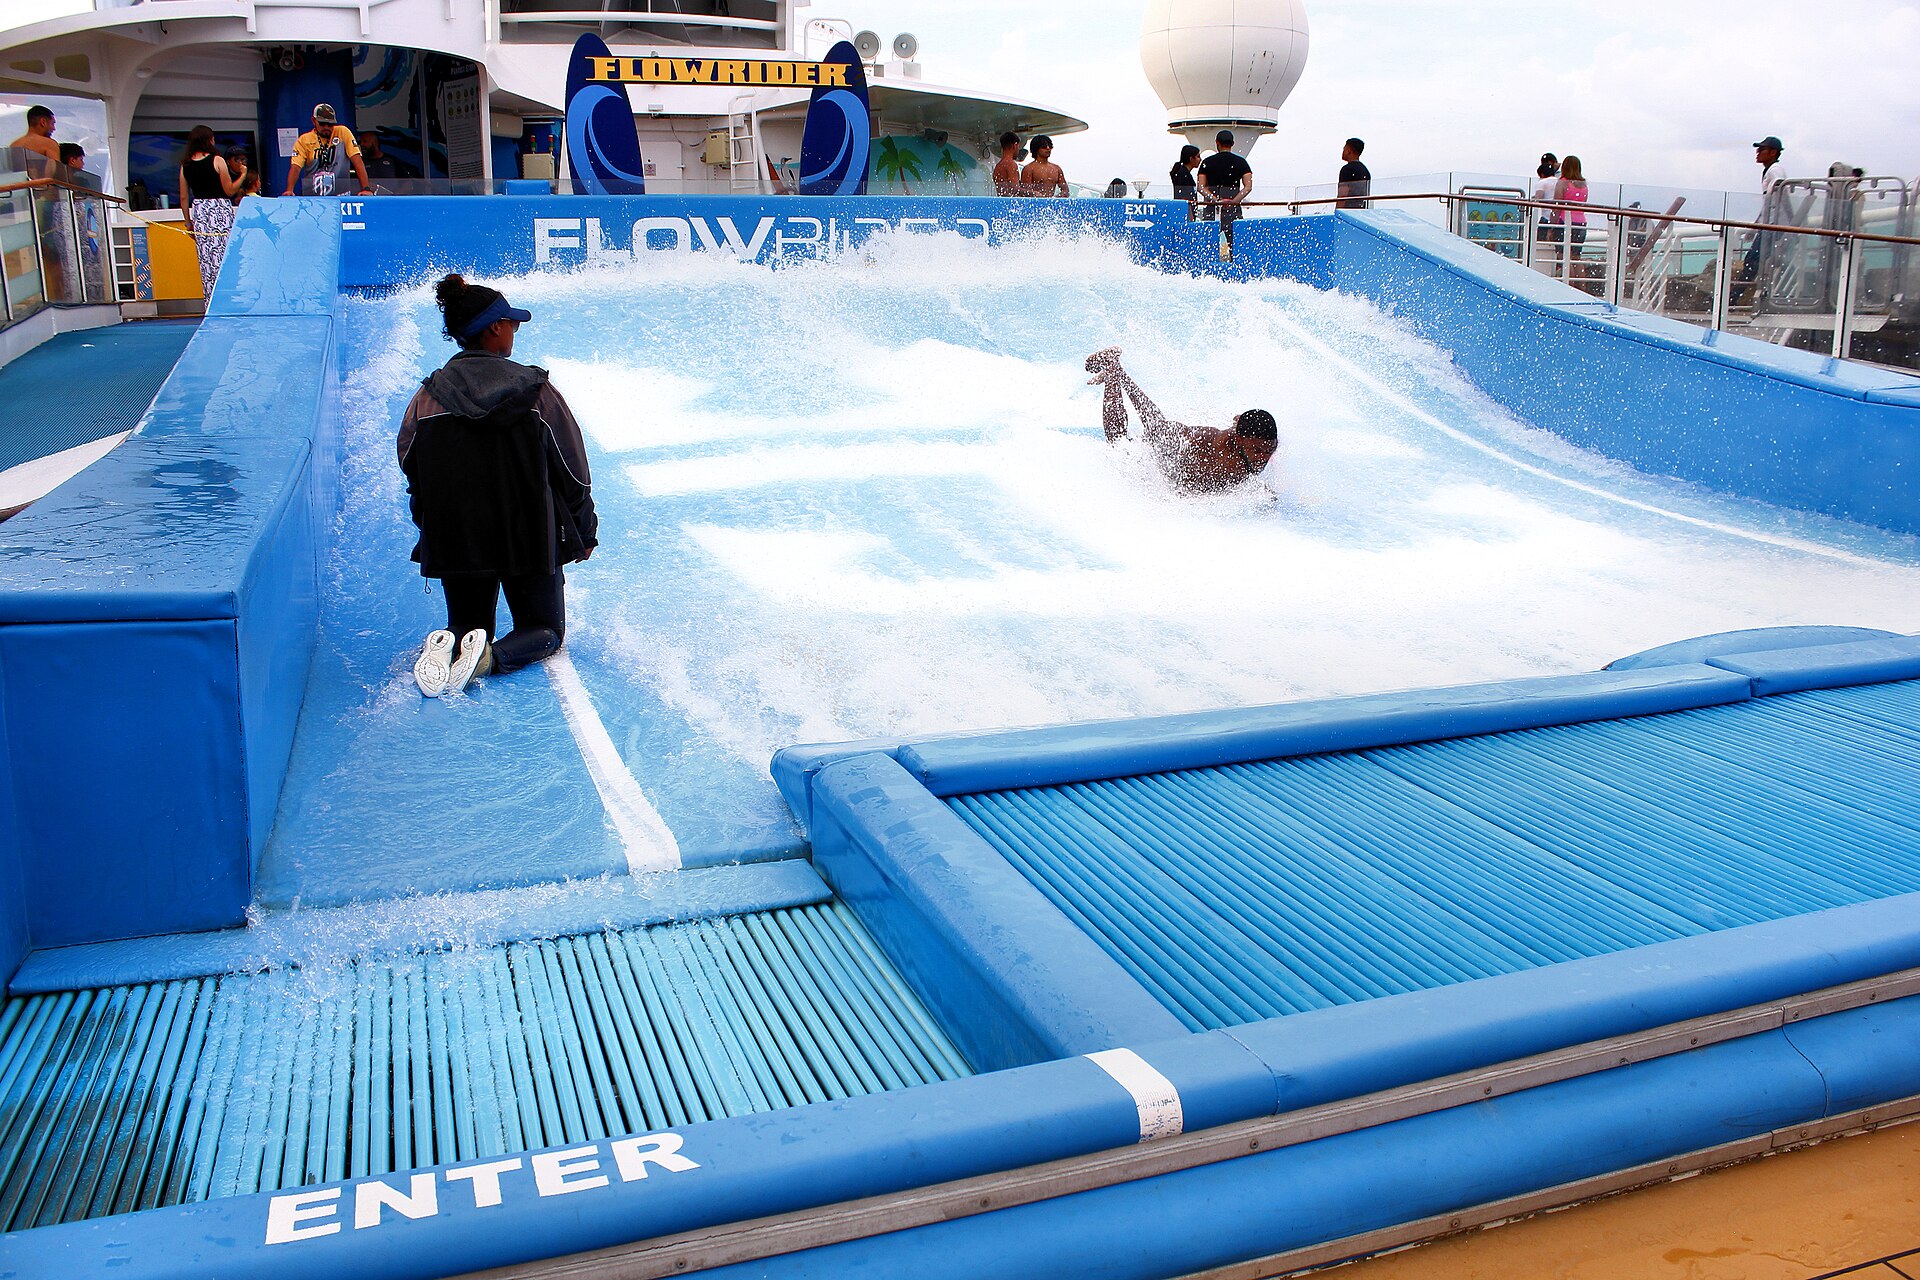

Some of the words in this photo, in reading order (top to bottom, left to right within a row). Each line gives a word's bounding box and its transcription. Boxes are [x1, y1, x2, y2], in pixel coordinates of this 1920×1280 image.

[585, 57, 852, 86] FLOWRIDER
[340, 202, 365, 216] XIT
[1125, 203, 1156, 216] EXIT
[265, 1132, 701, 1245] ENTER
